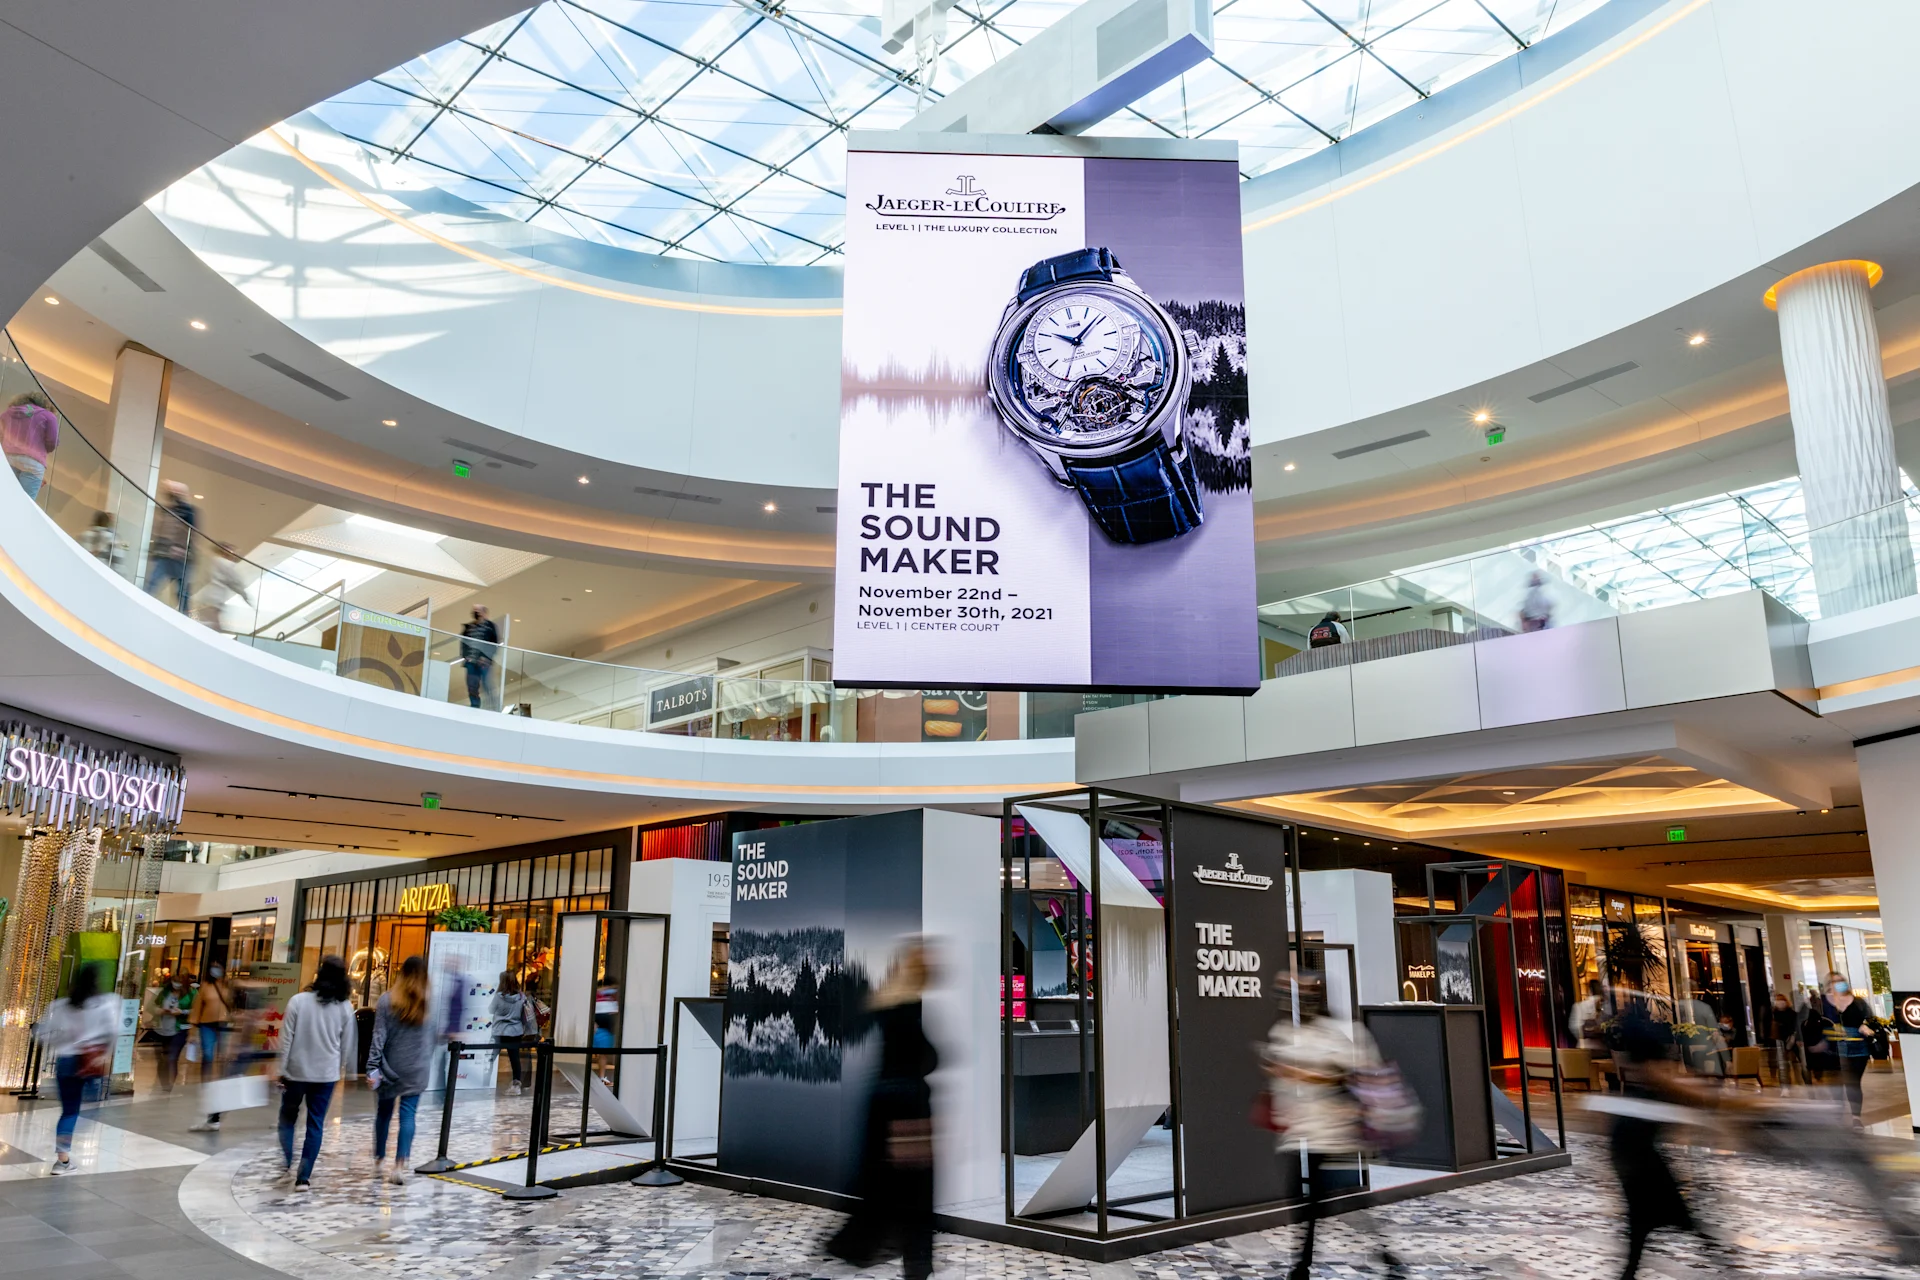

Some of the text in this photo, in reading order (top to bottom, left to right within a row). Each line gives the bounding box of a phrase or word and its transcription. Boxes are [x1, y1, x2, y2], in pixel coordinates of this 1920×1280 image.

[876, 223, 909, 231] LEVEL
[924, 224, 946, 232] THE
[947, 225, 990, 233] LUXURY
[992, 226, 1058, 235] COLLECTION
[861, 482, 936, 509] THE
[860, 514, 1000, 542] SOUND
[860, 547, 1000, 575] MAKER
[859, 586, 953, 600] November
[957, 587, 1001, 600] 22nd
[858, 604, 1052, 621] November 30th, 2021
[857, 621, 893, 630] LEVEL
[911, 622, 957, 631] CENTER
[960, 623, 1000, 632] COURT
[656, 688, 708, 712] TALBOTS
[6, 747, 166, 813] SWAROVSKI
[737, 842, 766, 861] THE
[737, 860, 789, 881] SOUND
[398, 883, 451, 913] ARITZIA
[736, 881, 788, 901] MAKER
[1195, 923, 1233, 945] THE
[1196, 949, 1261, 972] SOUND
[1516, 968, 1546, 979] MAC
[1198, 975, 1262, 998] MAKER
